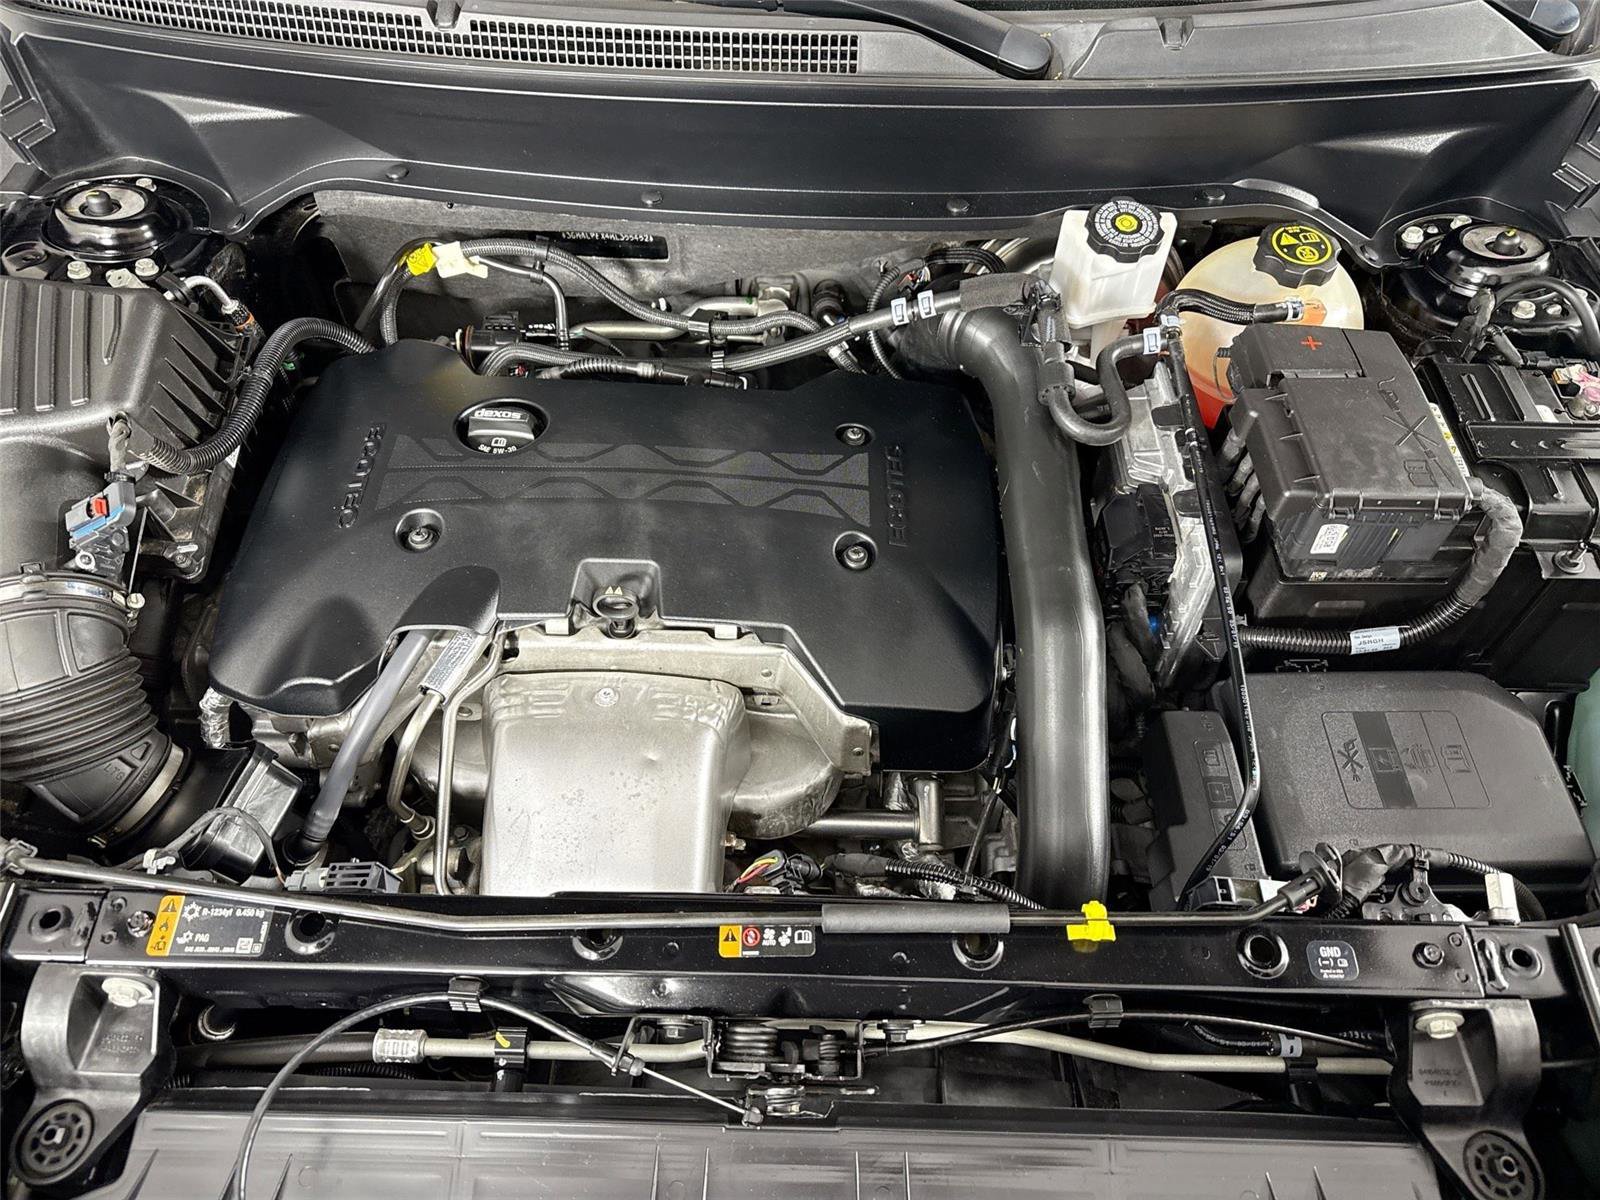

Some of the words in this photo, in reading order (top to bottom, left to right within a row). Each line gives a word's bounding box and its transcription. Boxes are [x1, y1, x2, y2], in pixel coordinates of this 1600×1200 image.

[474, 408, 521, 419] dexos
[478, 444, 491, 453] SAE
[493, 446, 517, 454] 5W-30
[202, 907, 233, 918] R-1234yf
[236, 908, 255, 917] 0.450
[256, 908, 265, 918] kg
[1320, 946, 1341, 957] GND
